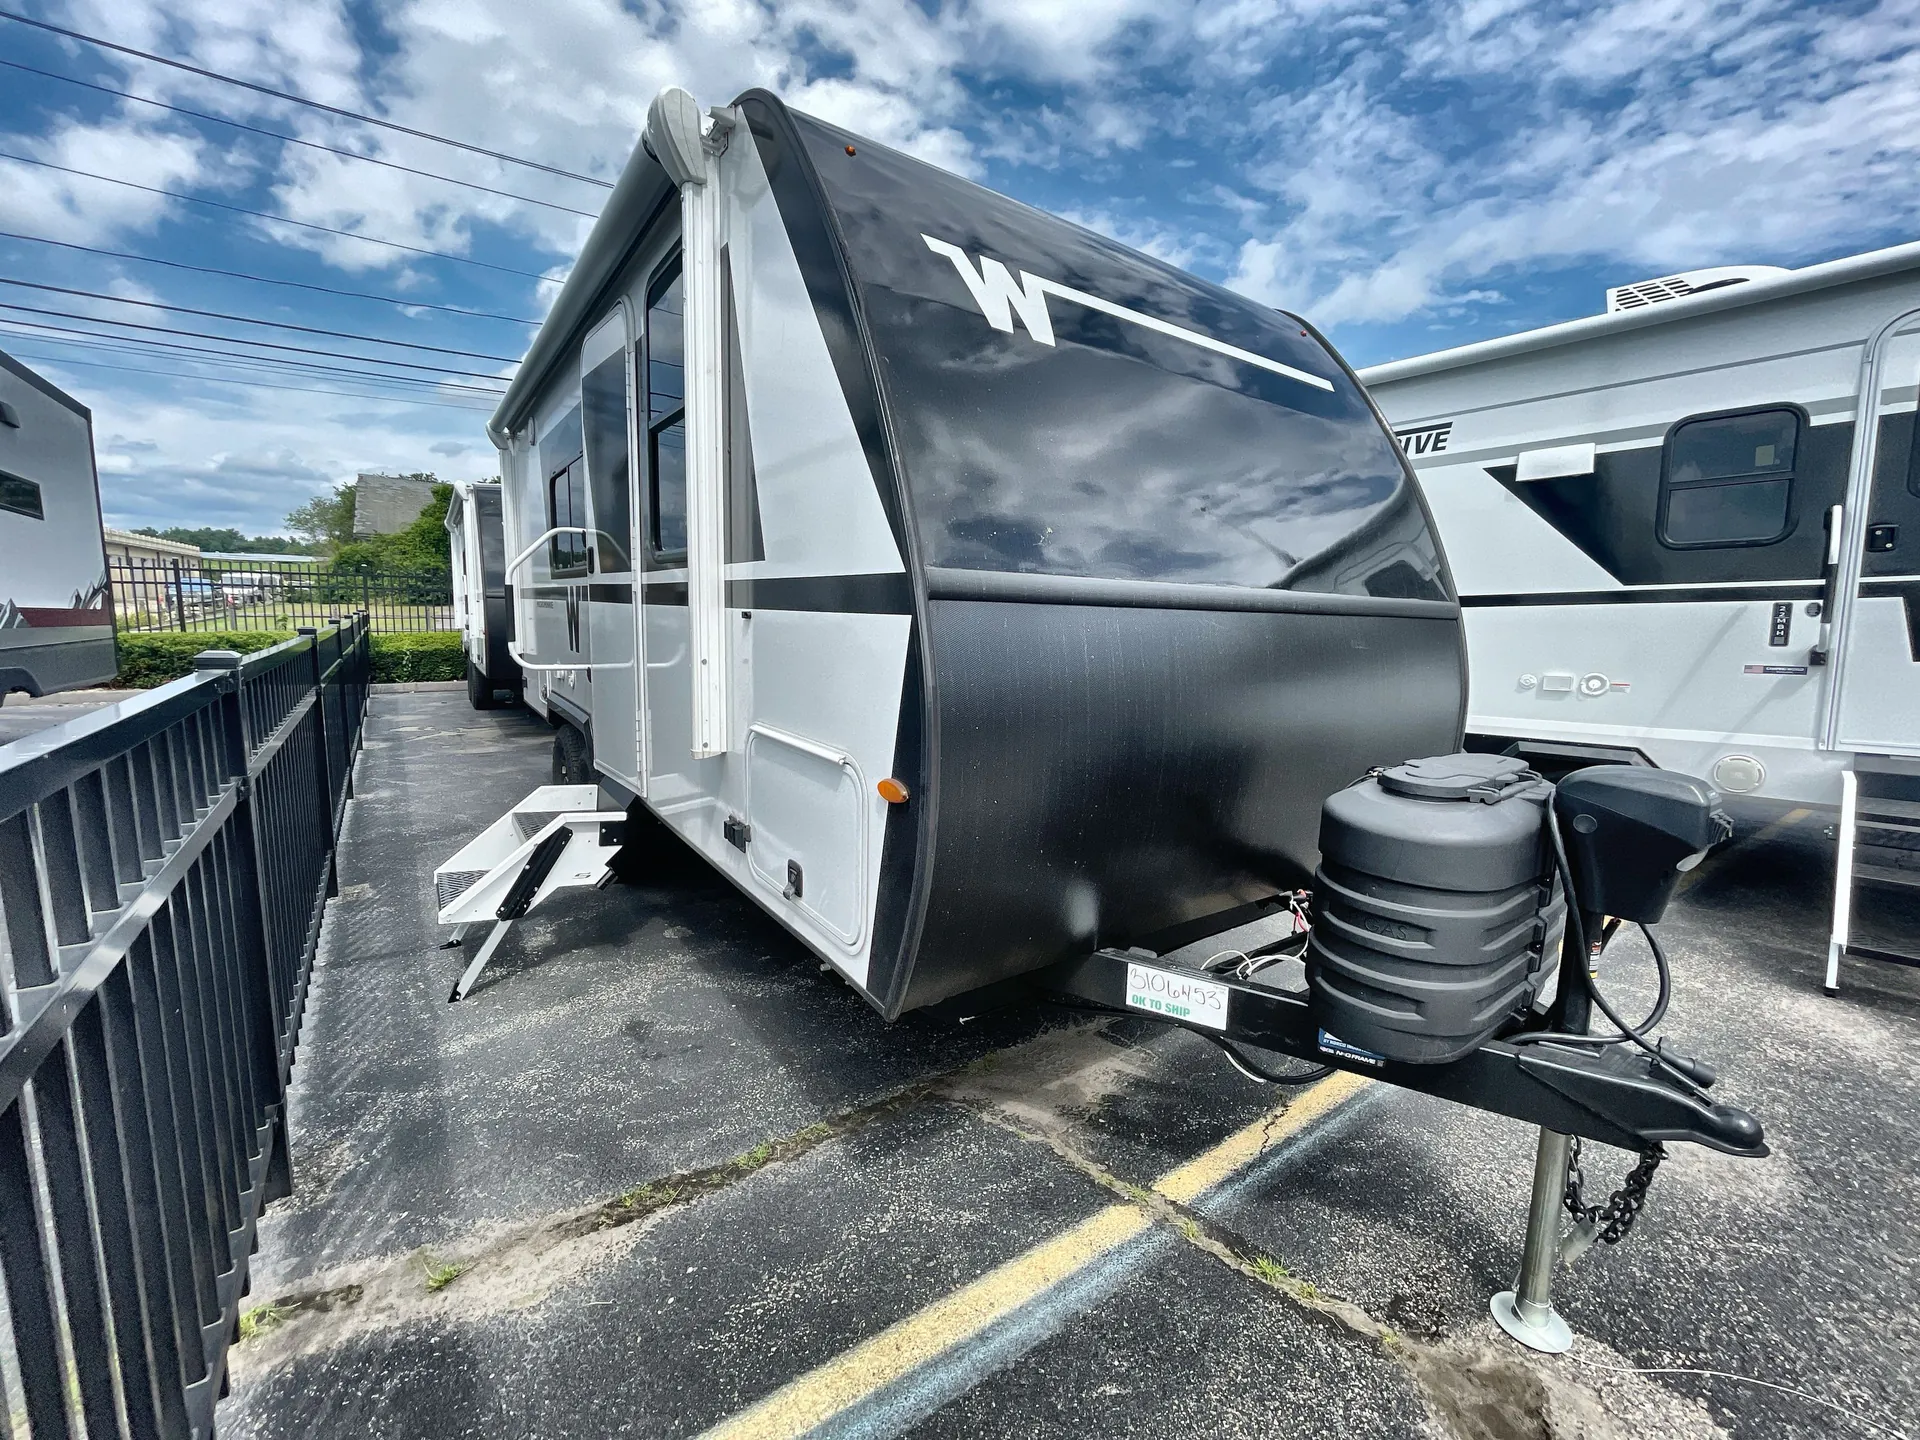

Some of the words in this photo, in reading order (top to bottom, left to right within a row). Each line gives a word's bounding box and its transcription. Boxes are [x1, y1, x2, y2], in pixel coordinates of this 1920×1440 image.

[1398, 430, 1451, 455] IVE
[1364, 917, 1407, 940] GAS
[1132, 994, 1147, 1007] OK
[1149, 998, 1162, 1010] TO
[1164, 1003, 1191, 1017] SHIP
